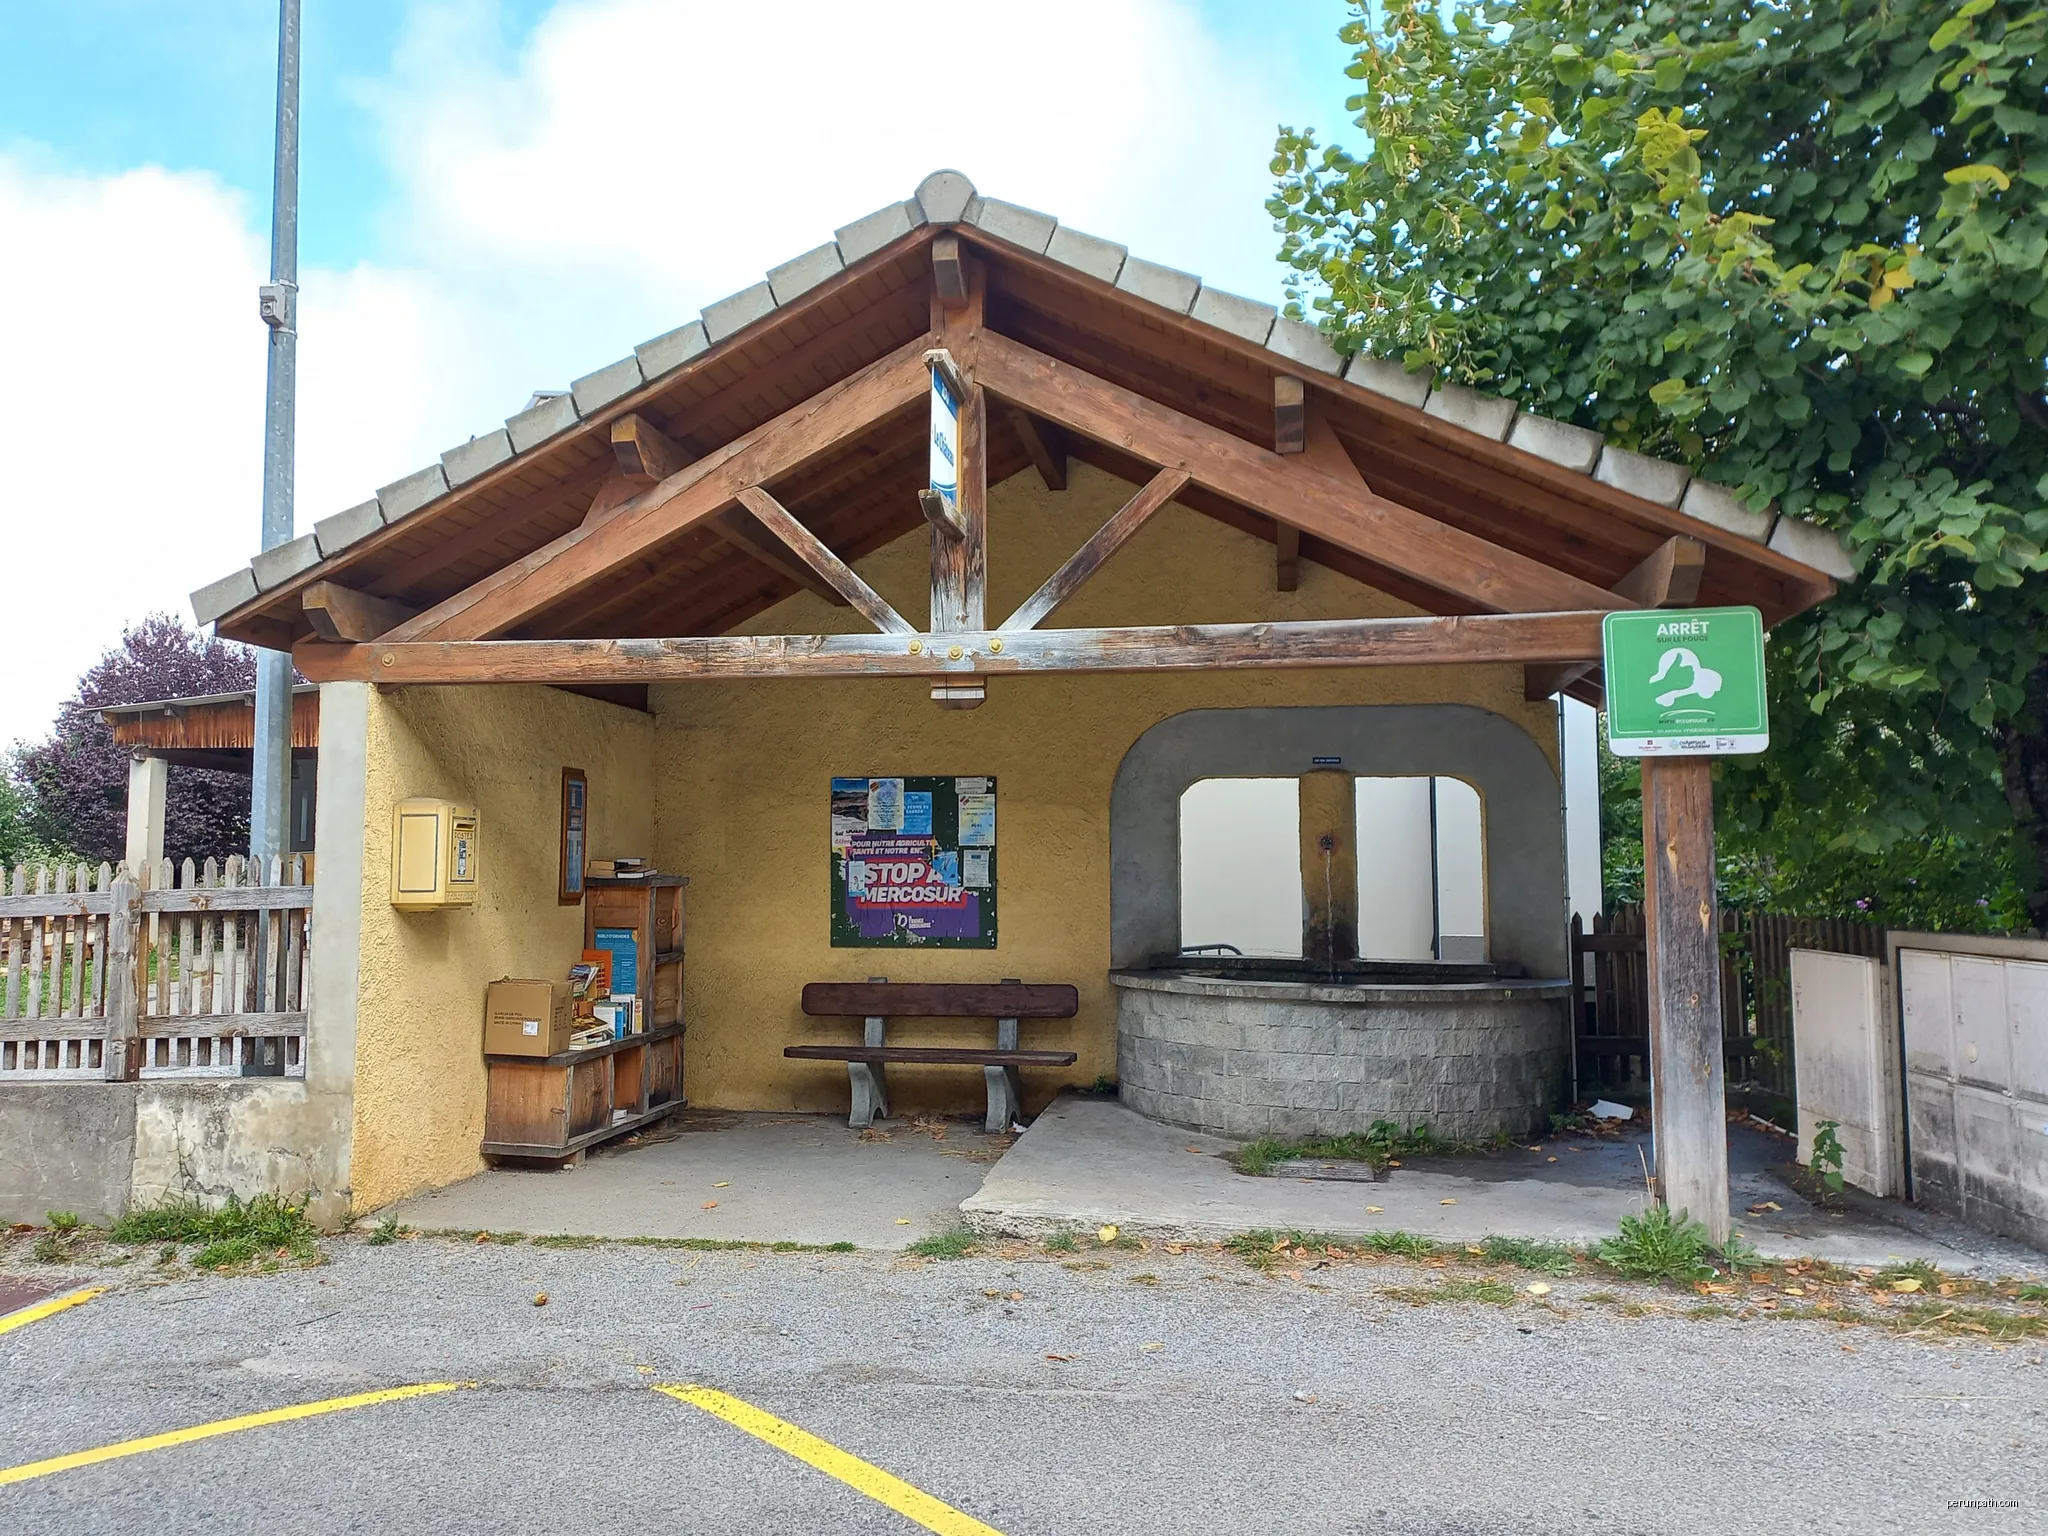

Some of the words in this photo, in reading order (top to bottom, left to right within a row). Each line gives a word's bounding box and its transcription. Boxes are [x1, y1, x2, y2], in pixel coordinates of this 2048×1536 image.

[1656, 618, 1710, 636] ARRÊT
[454, 832, 473, 840] POSTES
[851, 840, 871, 848] POUR
[864, 862, 925, 884] STOP
[861, 886, 963, 902] MERCOSUR
